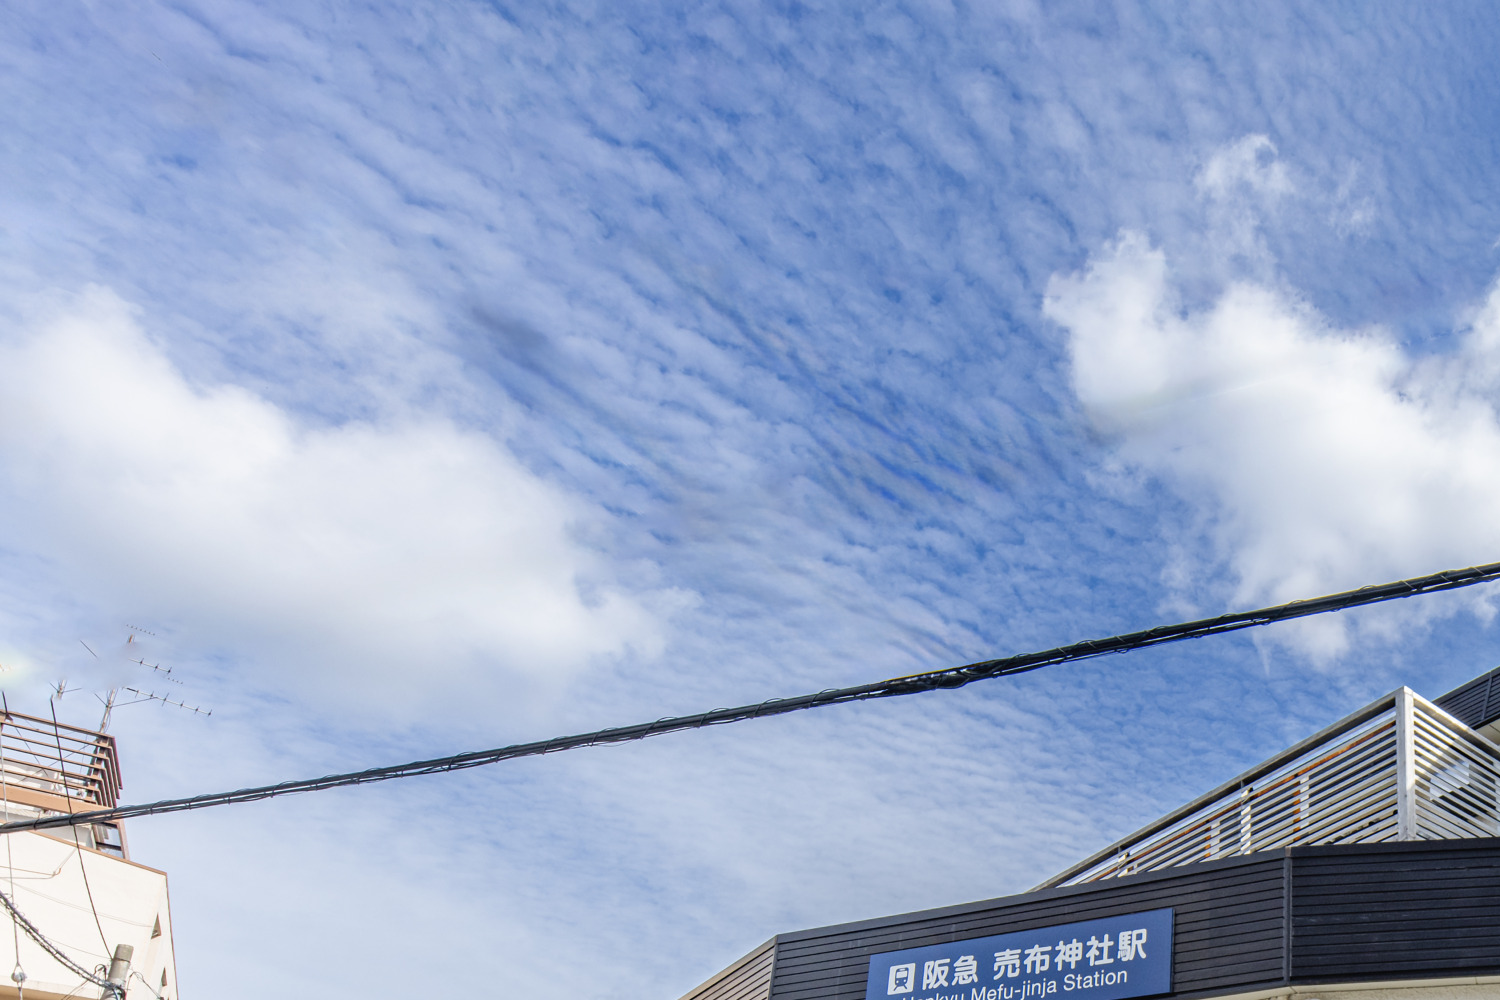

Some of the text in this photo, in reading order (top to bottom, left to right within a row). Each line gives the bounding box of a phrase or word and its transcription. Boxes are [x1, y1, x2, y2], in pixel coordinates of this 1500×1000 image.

[922, 928, 1147, 990] 阪急 売布神社駅
[1063, 968, 1128, 991] Station
